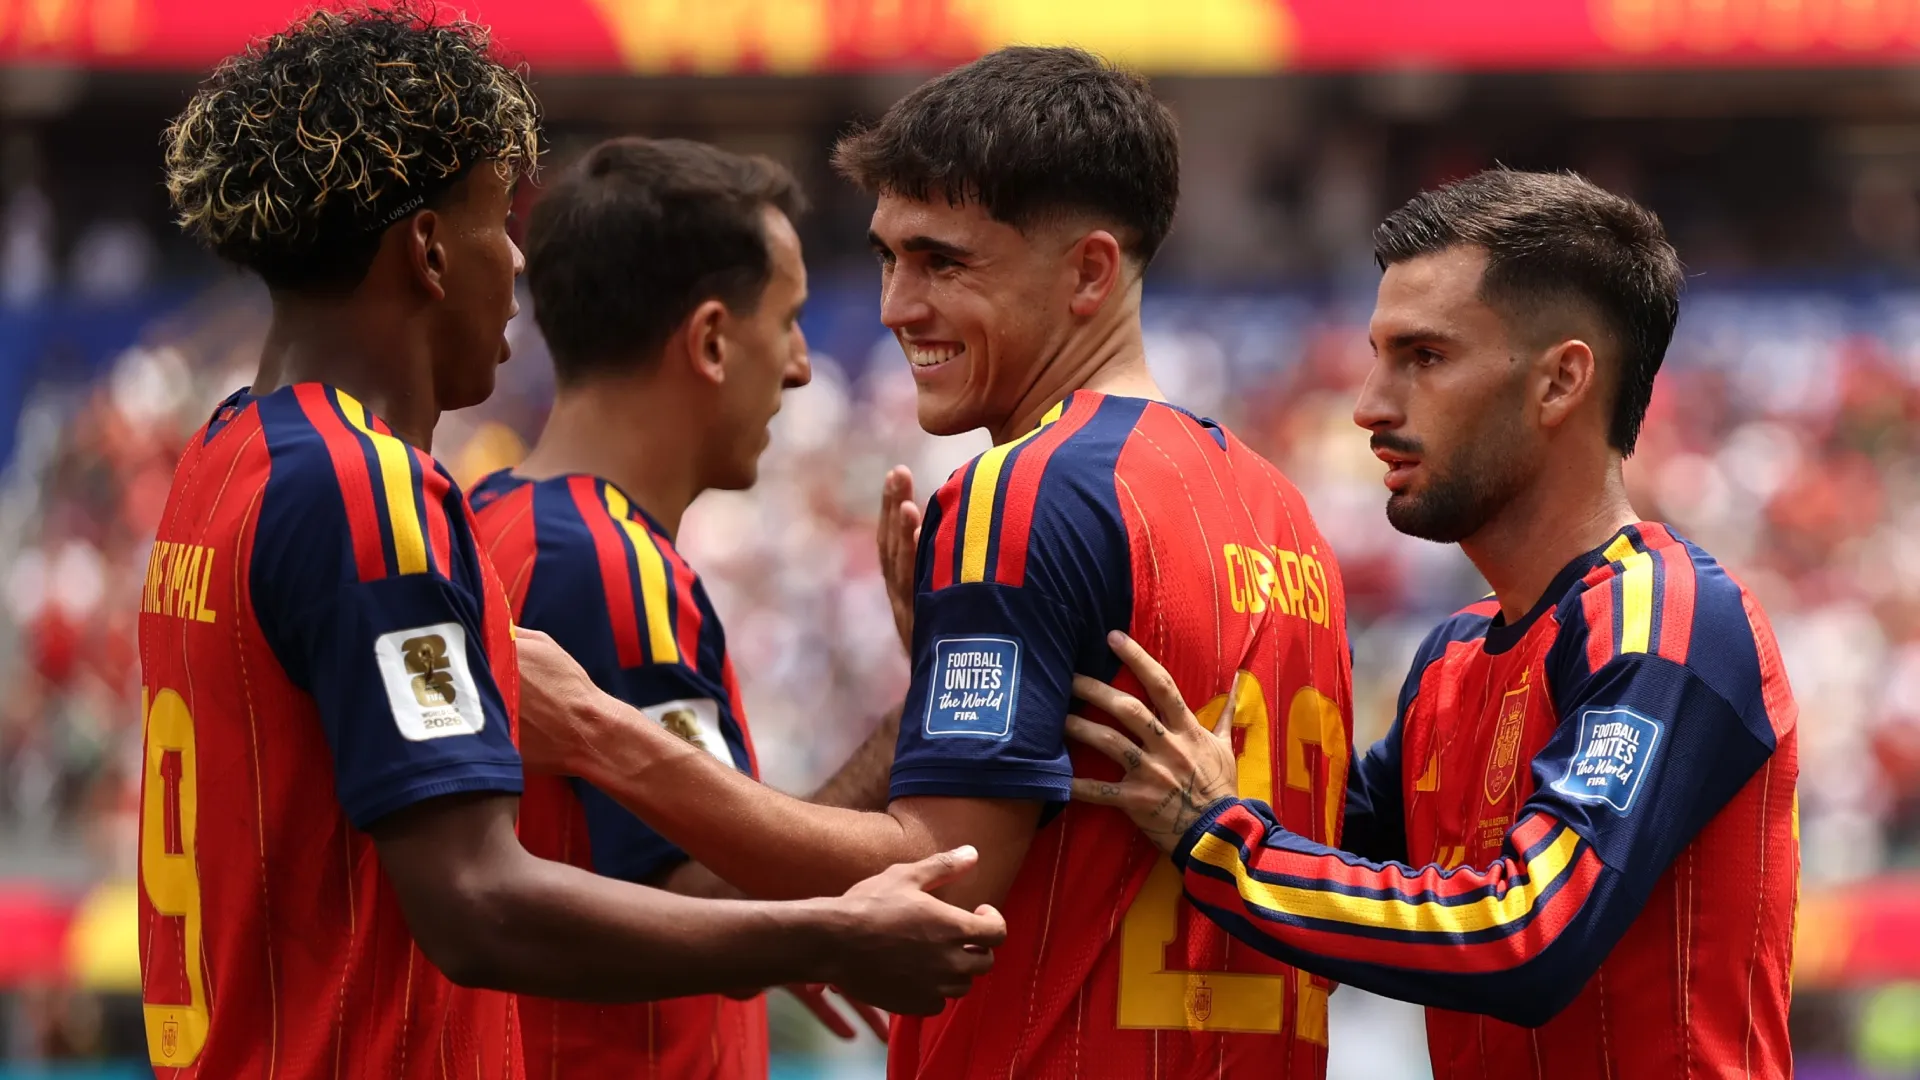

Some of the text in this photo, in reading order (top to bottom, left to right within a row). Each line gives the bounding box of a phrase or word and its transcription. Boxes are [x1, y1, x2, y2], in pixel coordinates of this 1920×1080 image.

[947, 652, 1003, 668] FOOTBALL
[944, 668, 1002, 690] UNITES
[939, 689, 1004, 711] the World
[954, 711, 977, 721] FIFA
[1592, 722, 1640, 746] FOOTBALL
[1585, 737, 1637, 765] UNITES
[1576, 758, 1633, 786] the World
[1586, 776, 1606, 787] FIFA
